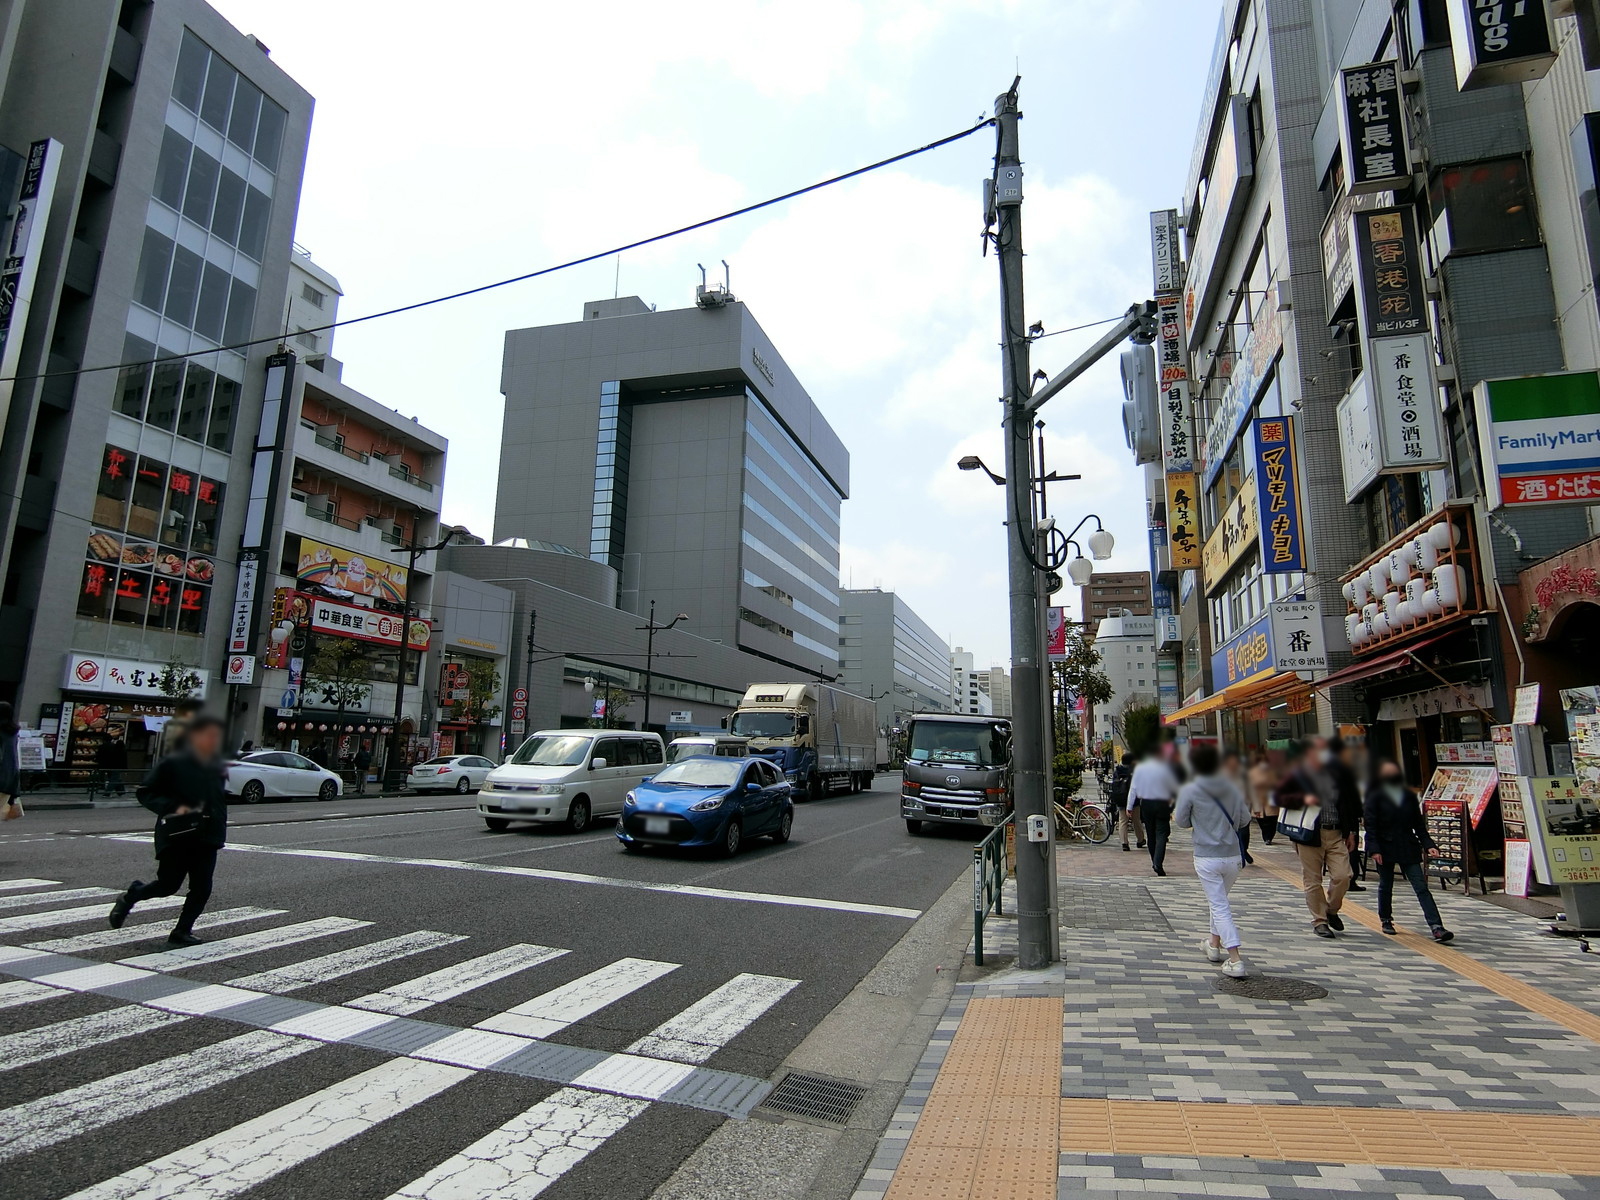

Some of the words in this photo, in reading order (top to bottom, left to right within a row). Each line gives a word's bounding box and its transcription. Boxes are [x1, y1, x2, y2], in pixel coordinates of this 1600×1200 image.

[1346, 67, 1396, 97] 麻雀
[1358, 98, 1396, 178] 社長室
[1154, 225, 1170, 283] 宮本クリニック
[1374, 244, 1411, 316] 香港苑
[1376, 319, 1420, 332] 当ビル3F
[1162, 368, 1187, 380] 190円
[1168, 388, 1188, 459] 目利きの銀次
[1262, 423, 1282, 441] 薬
[1498, 429, 1600, 450] FamilyMart
[1516, 474, 1600, 500] 酒・たばこ
[1172, 489, 1197, 553] 千年の宴
[1261, 447, 1293, 563] マツモトキヨシ
[116, 577, 202, 611] 土古里
[241, 563, 254, 599] 和牛焼肉
[235, 604, 249, 638] 土古里
[318, 609, 364, 630] 中華食堂
[1168, 616, 1177, 640] ena
[1284, 615, 1312, 653] 一番
